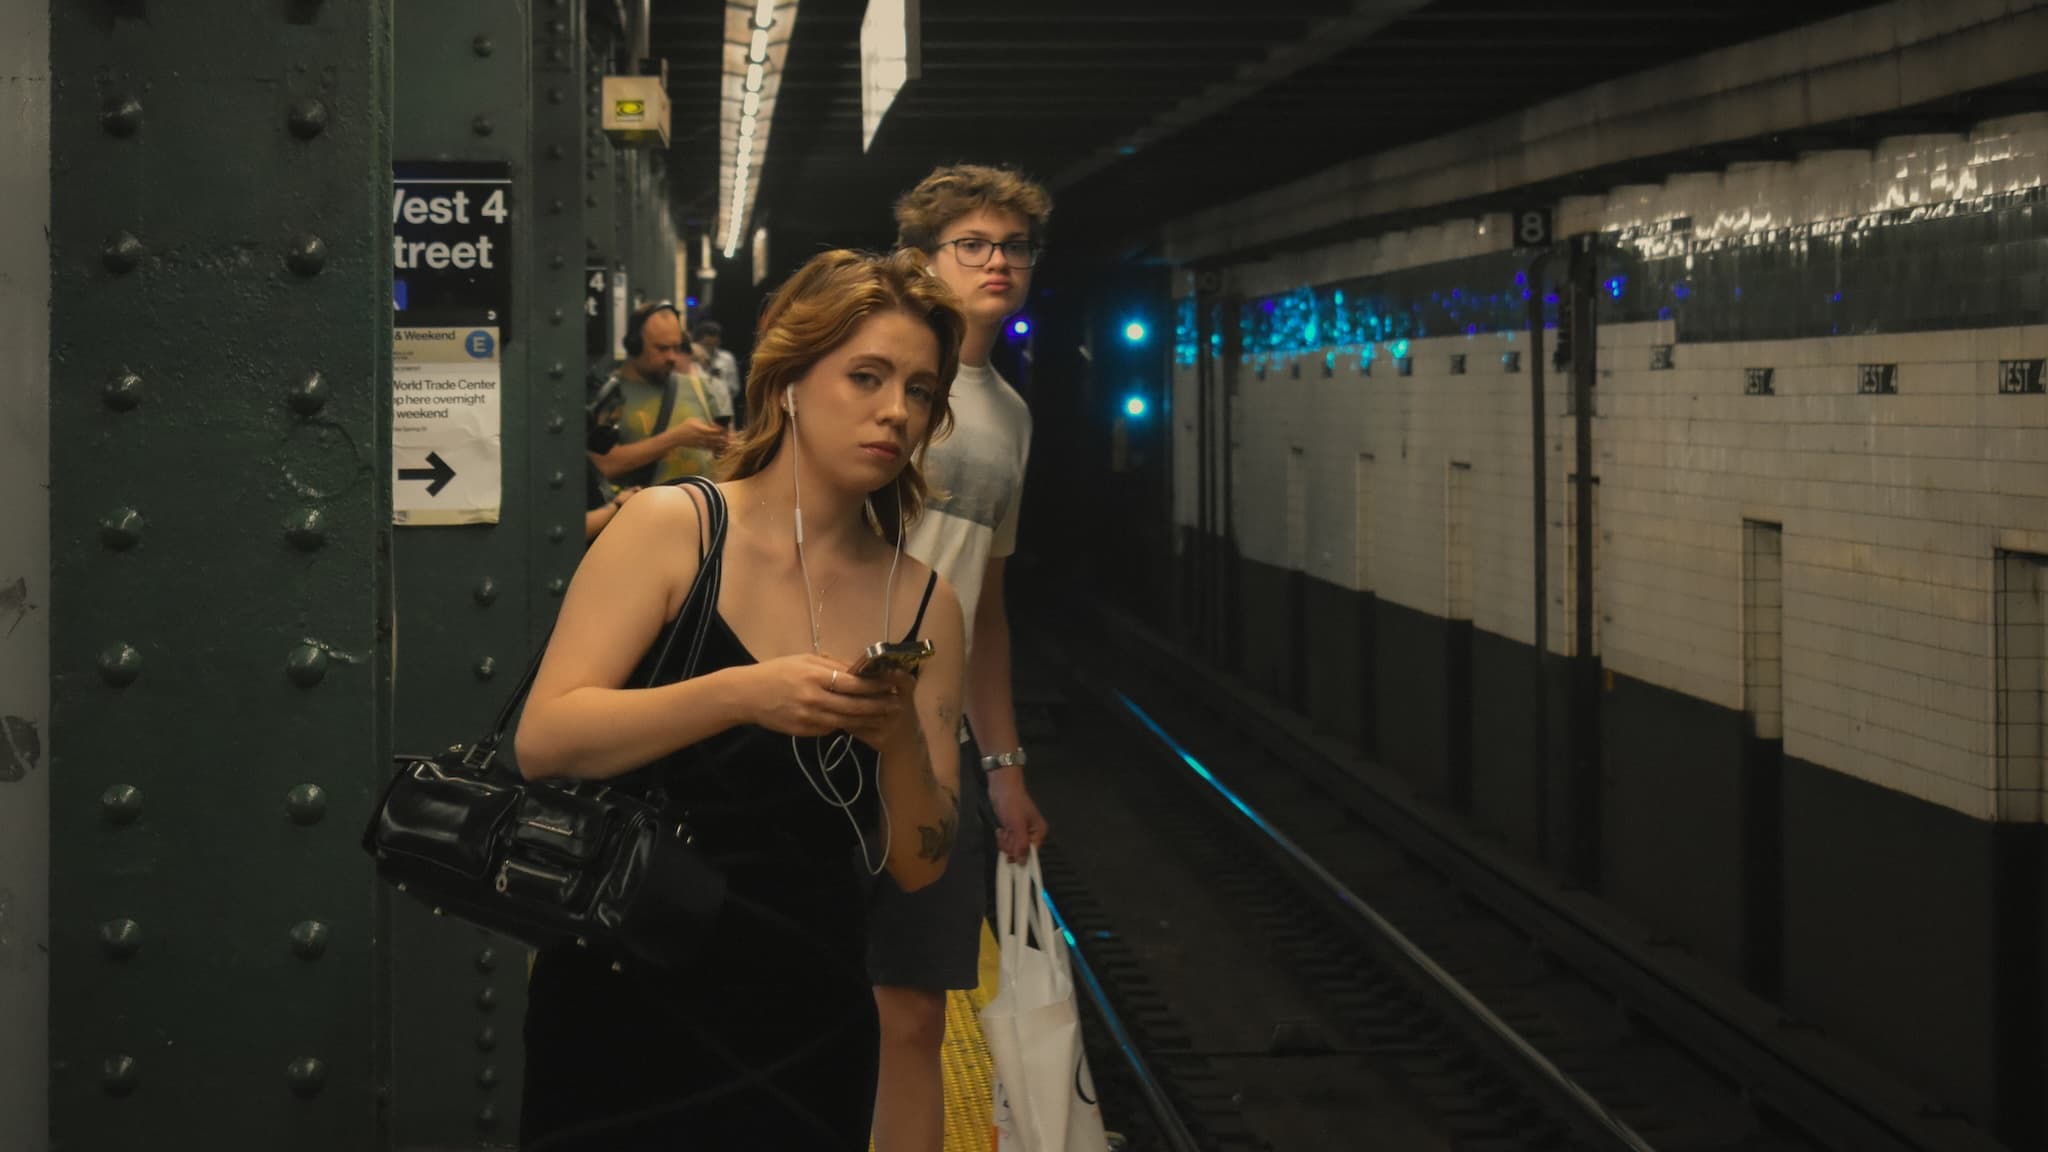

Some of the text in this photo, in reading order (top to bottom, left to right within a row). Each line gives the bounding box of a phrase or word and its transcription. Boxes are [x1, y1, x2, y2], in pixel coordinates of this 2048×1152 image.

[481, 189, 508, 224] 4
[1520, 212, 1544, 243] 8
[393, 236, 493, 269] treet
[589, 272, 605, 292] 4
[487, 310, 497, 321] 3
[394, 330, 456, 341] & Weekend
[472, 336, 487, 353] E
[424, 380, 456, 391] Trade
[458, 379, 496, 391] Center
[405, 395, 431, 404] here
[433, 395, 485, 406] overnight
[396, 408, 448, 419] weekend
